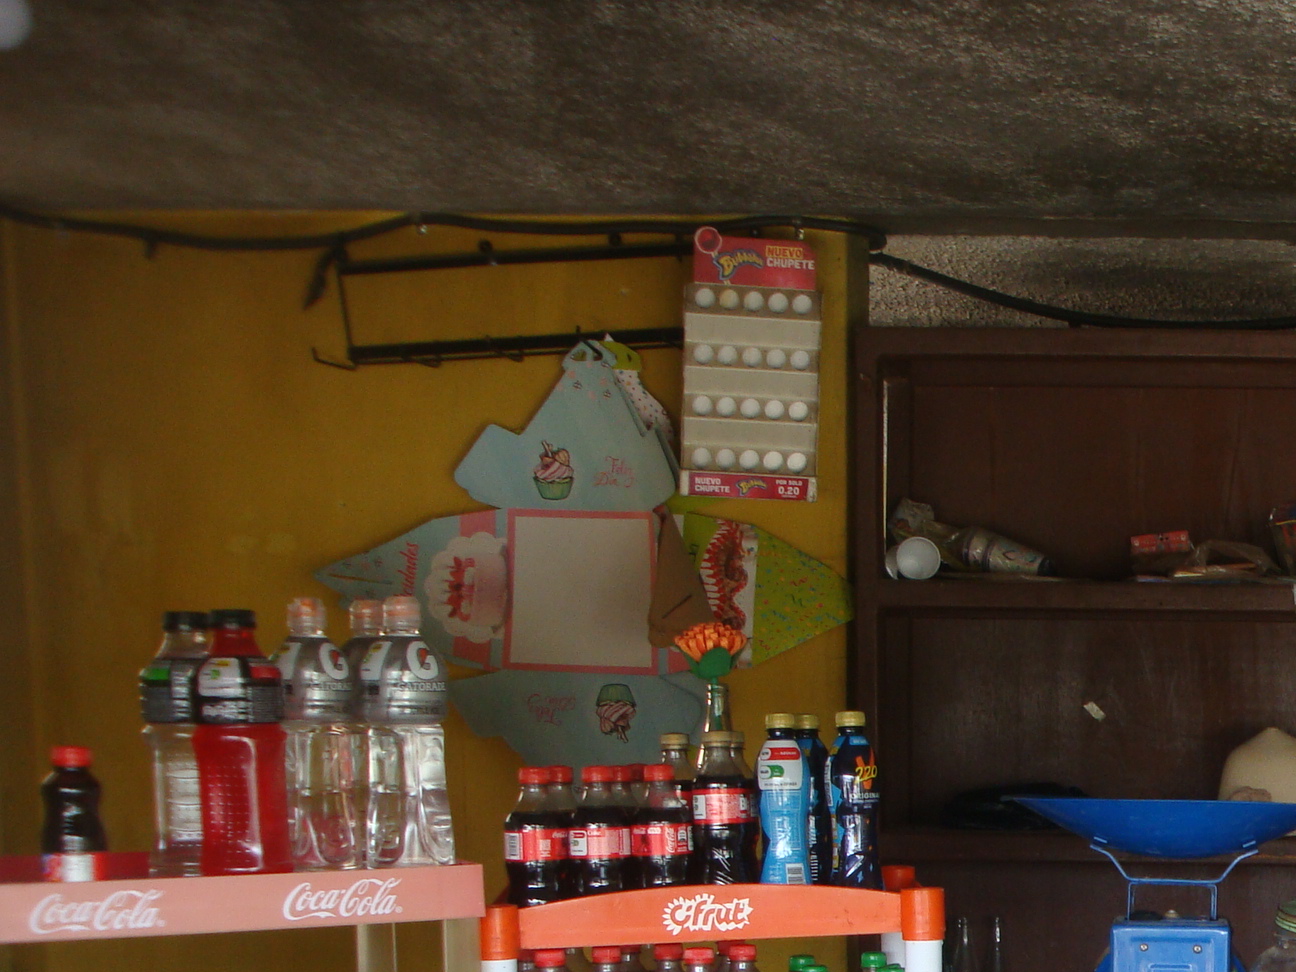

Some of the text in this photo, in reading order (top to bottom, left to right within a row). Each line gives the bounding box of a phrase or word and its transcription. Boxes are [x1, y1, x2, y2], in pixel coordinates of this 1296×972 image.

[766, 246, 803, 259] NUEVO
[766, 258, 815, 270] CHUPETE
[695, 477, 721, 485] NUEVO
[695, 485, 730, 493] CHUPETE
[778, 486, 800, 495] 0.20
[283, 877, 402, 921] Coca-Cola
[29, 889, 165, 935] Coca-Cola
